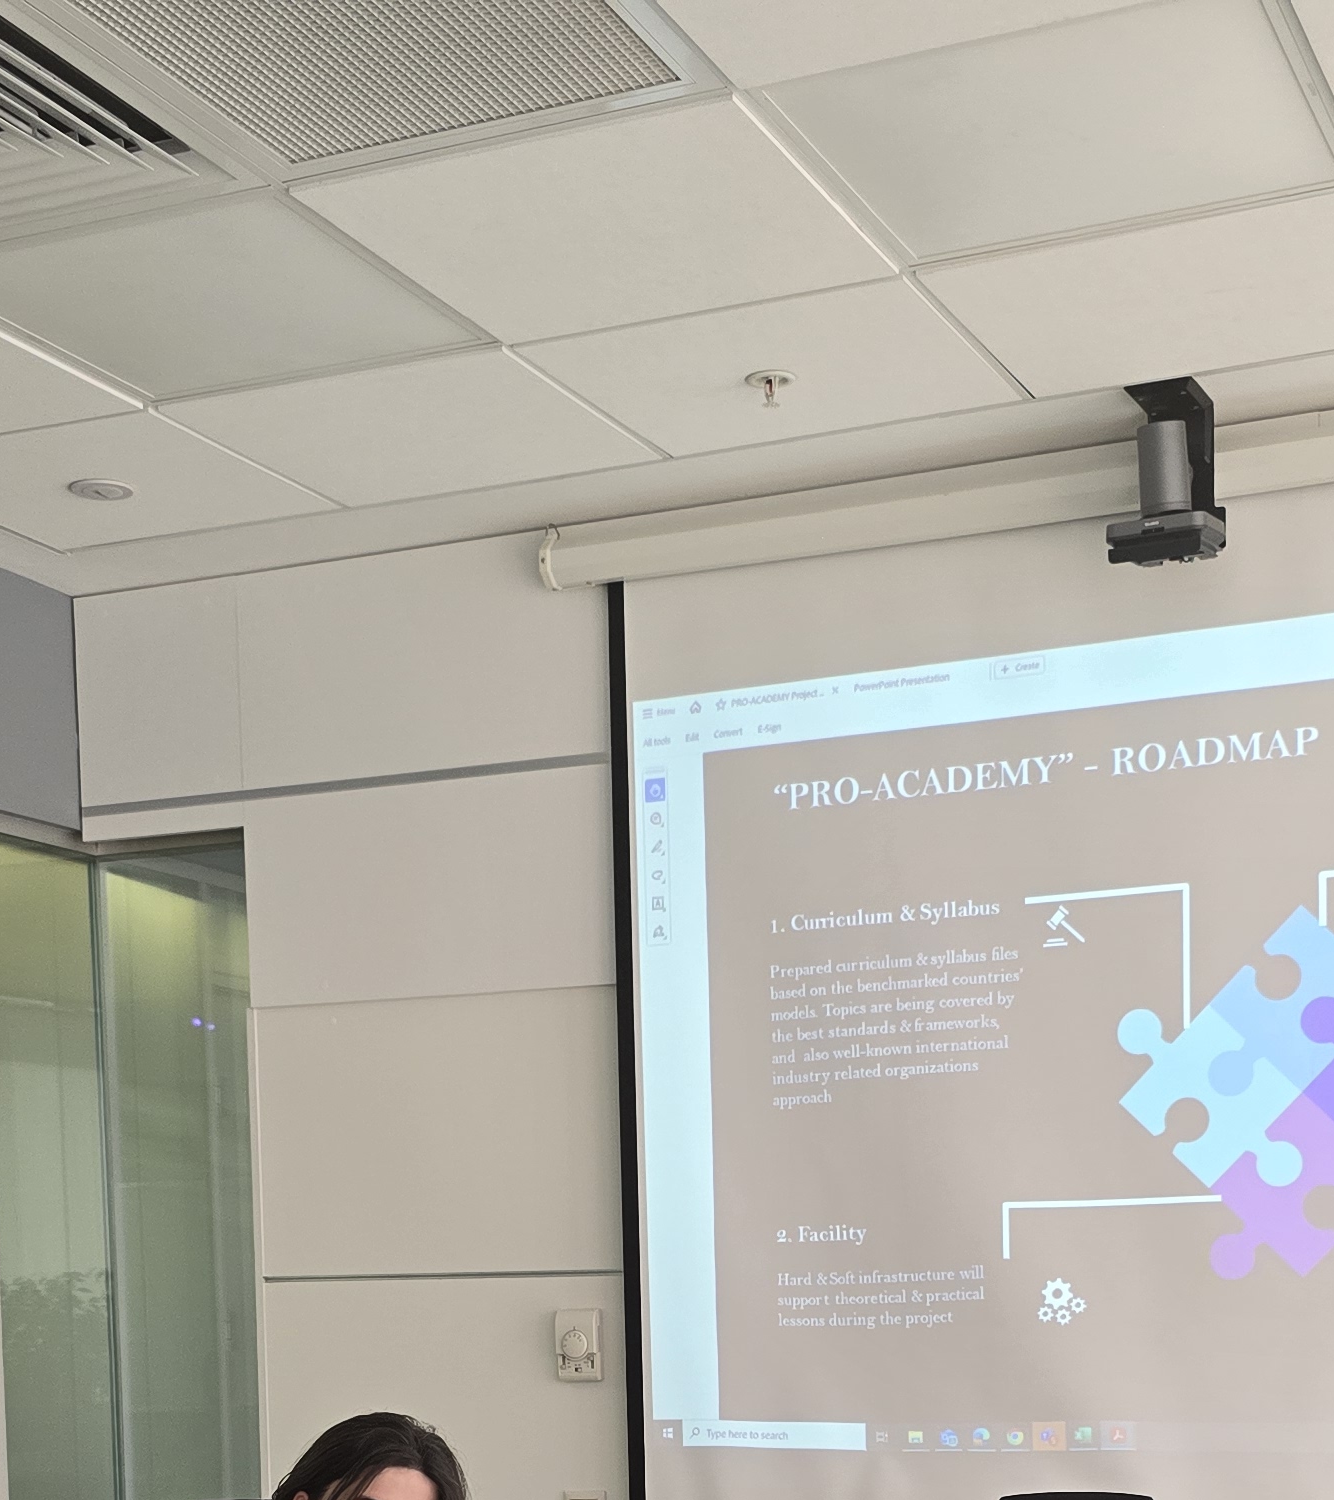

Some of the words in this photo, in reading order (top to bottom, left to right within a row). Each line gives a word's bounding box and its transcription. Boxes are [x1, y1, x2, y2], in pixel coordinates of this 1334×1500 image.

[1015, 660, 1040, 672] Create
[854, 679, 898, 693] PowerPoint
[901, 672, 950, 689] Presentation
[731, 692, 790, 709] PRO-ACADEMY
[791, 689, 819, 702] Project
[685, 732, 700, 743] Edit
[713, 727, 743, 739] Convert
[757, 722, 782, 735] E-Sign
[643, 737, 652, 748] All
[654, 735, 671, 746] tools
[1112, 726, 1320, 776] ROADMAP
[771, 920, 785, 934] 1.
[791, 910, 893, 931] Curriculum
[900, 905, 915, 922] &
[920, 900, 1000, 925] Syllabus
[770, 960, 832, 980] Prepared
[836, 954, 913, 972] curriculum
[916, 953, 928, 966] &
[930, 949, 987, 969] syllabus
[991, 946, 1019, 961] files
[770, 986, 806, 1000] based
[810, 986, 826, 997] on
[831, 982, 853, 995] the
[857, 972, 948, 993] benchmarked
[771, 1007, 818, 1021] models.
[822, 1001, 866, 1019] Topics
[870, 1002, 892, 1013] are
[896, 996, 935, 1014] being
[939, 992, 993, 1008] covered
[997, 991, 1015, 1009] by
[772, 1029, 793, 1043] the
[797, 1025, 824, 1041] best
[828, 1019, 896, 1038] standards
[900, 1018, 912, 1032] &
[914, 1014, 1000, 1032] frameworks,
[772, 1050, 796, 1064] and
[803, 1047, 829, 1062] also
[833, 1043, 912, 1060] well-known
[916, 1035, 1009, 1054] international
[772, 1070, 831, 1086] industry
[834, 1064, 881, 1081] related
[885, 1058, 979, 1080] organizations
[772, 1089, 832, 1109] approach
[776, 1229, 793, 1243] 2.
[798, 1225, 867, 1245] Facility
[777, 1272, 812, 1286] Hard
[816, 1273, 828, 1286] &
[829, 1269, 855, 1285] Soft
[859, 1267, 955, 1285] infrastructure
[959, 1265, 984, 1280] will
[777, 1293, 830, 1309] support
[835, 1287, 907, 1305] theoretical
[911, 1290, 923, 1303] &
[926, 1286, 985, 1306] practical
[778, 1312, 825, 1327] lessons
[828, 1311, 876, 1329] during
[880, 1311, 902, 1326] the
[905, 1311, 953, 1328] project
[707, 1429, 726, 1441] Type
[728, 1429, 747, 1439] here
[749, 1430, 758, 1439] to
[761, 1430, 788, 1440] search
